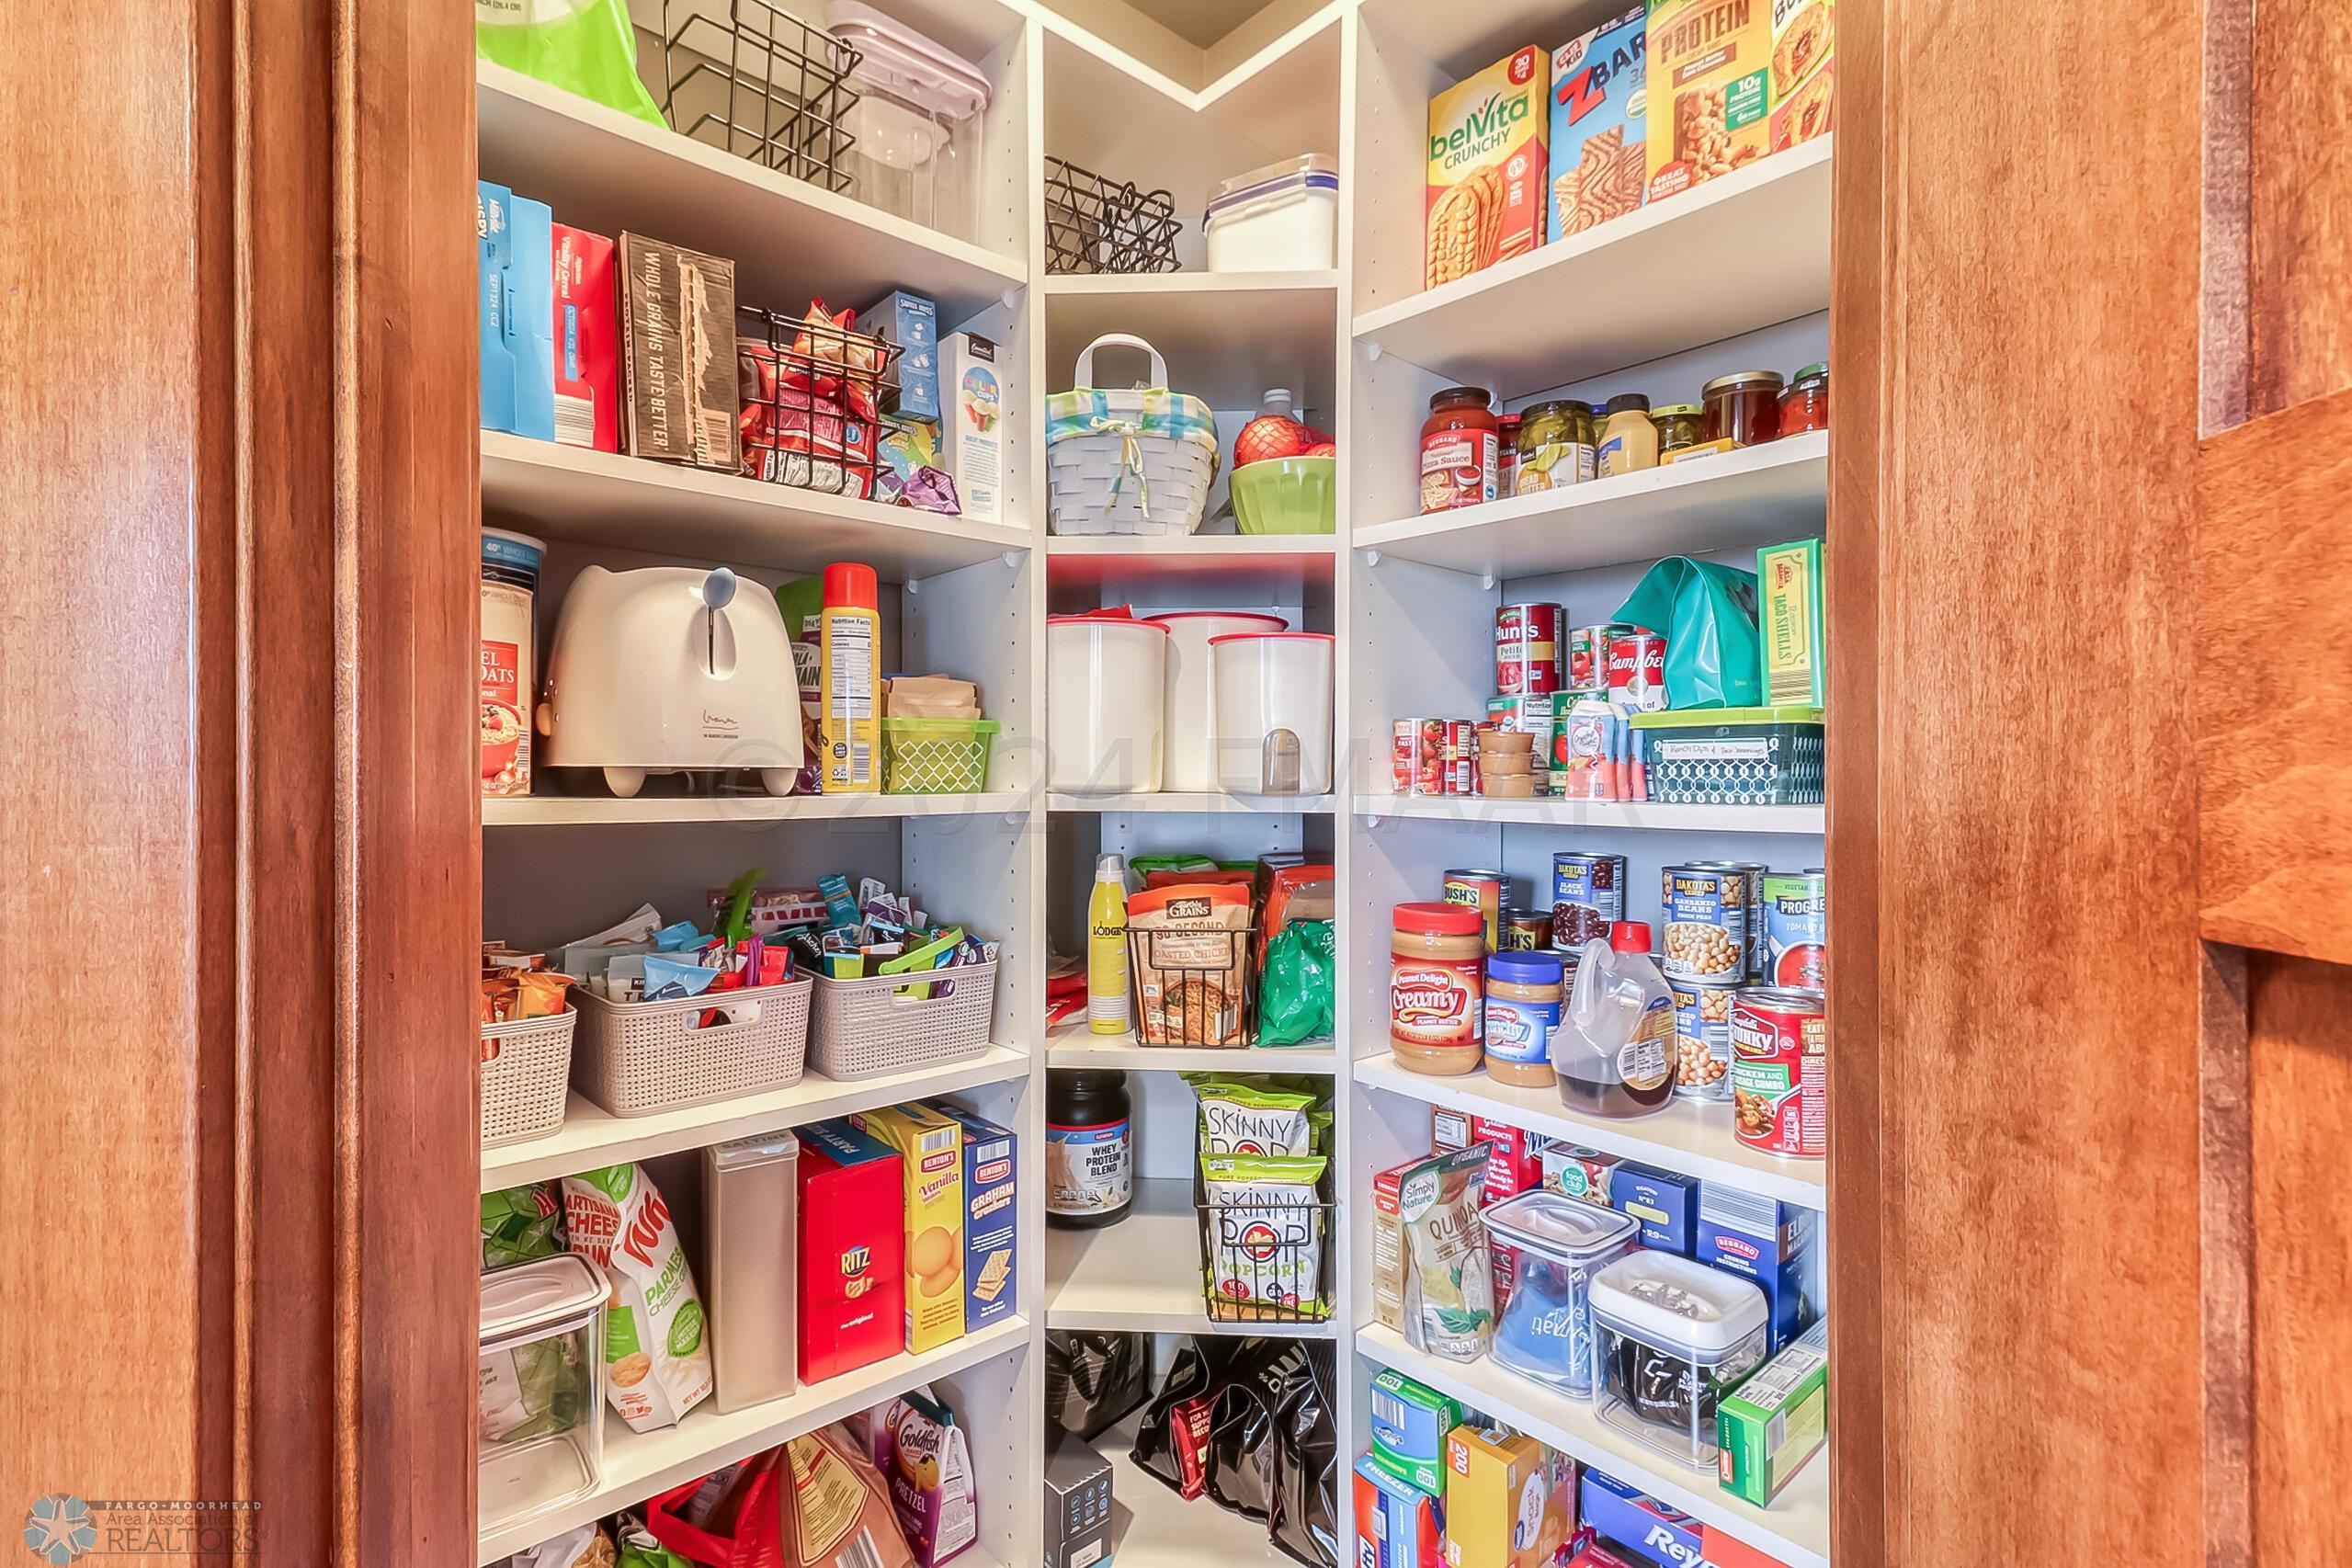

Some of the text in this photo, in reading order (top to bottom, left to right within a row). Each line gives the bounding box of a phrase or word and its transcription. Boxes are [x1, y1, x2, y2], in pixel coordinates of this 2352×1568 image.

[1660, 0, 1750, 65] PROTEIN
[1430, 92, 1528, 162] belVita
[1444, 127, 1511, 169] CRUNCHY
[1653, 166, 1686, 187] GREAT
[644, 251, 668, 447] WHOLE GRAINS TASTE BETTER
[1440, 455, 1471, 465] Sauce
[1775, 593, 1792, 660] TACO SHELLS
[482, 651, 500, 665] EL
[1609, 649, 1664, 673] Campbe
[1559, 887, 1585, 895] BEANS
[1676, 879, 1715, 892] DAKOTA'S
[1169, 904, 1210, 917] GRAINS
[1674, 898, 1717, 907] GARBANZO
[1677, 904, 1712, 914] BEANS
[1092, 922, 1122, 937] LODGE
[1176, 921, 1225, 937] SECOND
[1153, 949, 1230, 960] OASTED CHICKE
[1419, 972, 1449, 986] Delight
[1392, 989, 1460, 1014] Creamy
[1477, 1126, 1514, 1142] PRODUCTS
[1085, 1152, 1121, 1167] PROTEIN
[1091, 1142, 1118, 1156] WHEY
[1450, 1145, 1489, 1166] ORGANIC
[924, 1152, 954, 1168] BENTON'S
[1090, 1163, 1118, 1176] BLEND
[918, 1172, 960, 1196] Vanilla
[1405, 1181, 1436, 1199] Simply
[565, 1193, 619, 1219] ARTISANA
[971, 1181, 1015, 1212] GRAHAM
[1429, 1200, 1480, 1241] QUINOA
[841, 1246, 871, 1274] RITZ
[644, 1241, 686, 1306] PARMES
[849, 1312, 873, 1328] original
[899, 1424, 940, 1454] Goldfish
[1455, 1442, 1468, 1475] 200
[1364, 1460, 1415, 1496] FREEZER
[894, 1477, 927, 1513] PRETZEL
